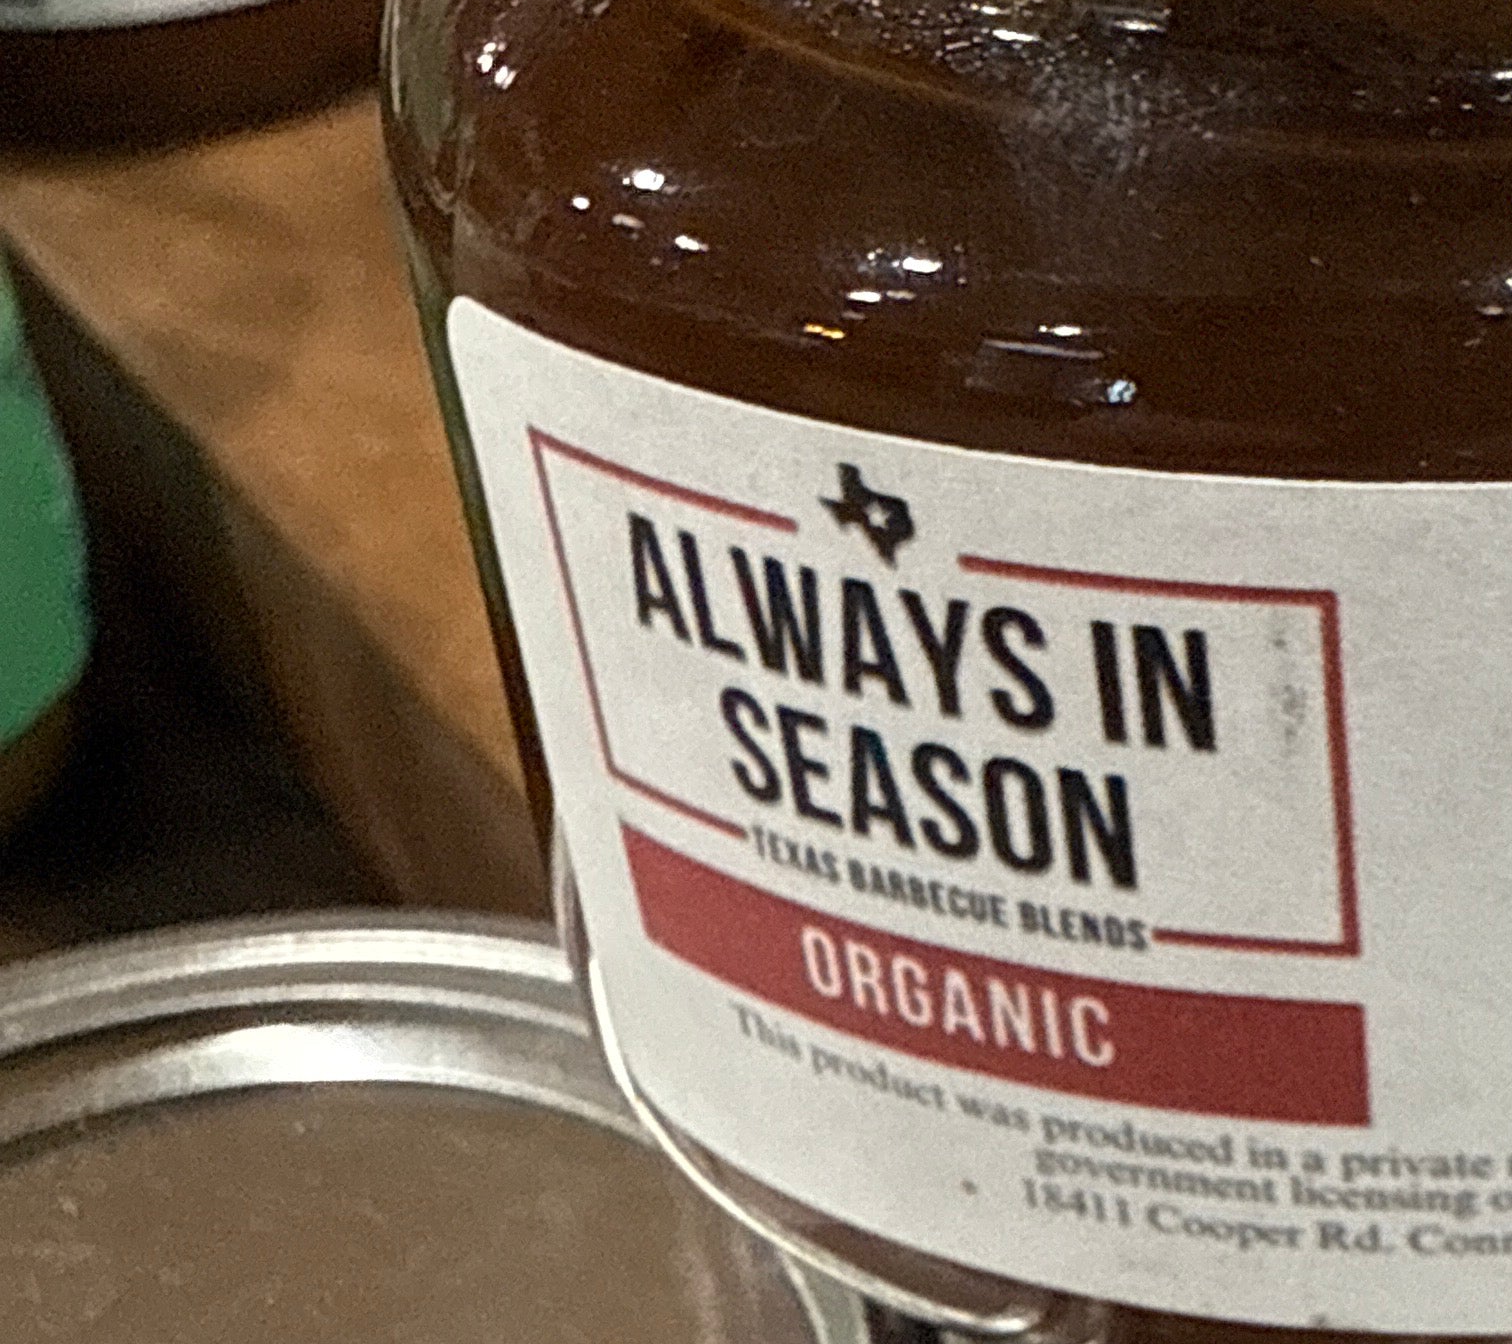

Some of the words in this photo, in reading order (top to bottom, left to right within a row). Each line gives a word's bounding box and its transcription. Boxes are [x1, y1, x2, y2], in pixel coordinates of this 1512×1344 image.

[626, 509, 1055, 735] ALWAYS
[1090, 618, 1216, 754] IN
[718, 684, 1138, 890] SEASON
[751, 824, 842, 885] TEXAS
[846, 856, 1010, 927] BARBECUE
[1017, 896, 1150, 951] BLENDS
[801, 923, 1116, 1068] ORGANIC
[728, 998, 801, 1061] This
[809, 1043, 948, 1111] product
[955, 1092, 1032, 1133] was
[1040, 1111, 1234, 1168] produced
[1247, 1134, 1290, 1172] in
[1301, 1149, 1325, 1174] a
[1339, 1145, 1494, 1185] private
[1034, 1147, 1279, 1206] government
[1289, 1173, 1480, 1222] licensing
[1146, 1201, 1304, 1251] Cooper
[1314, 1219, 1396, 1254] Rd.
